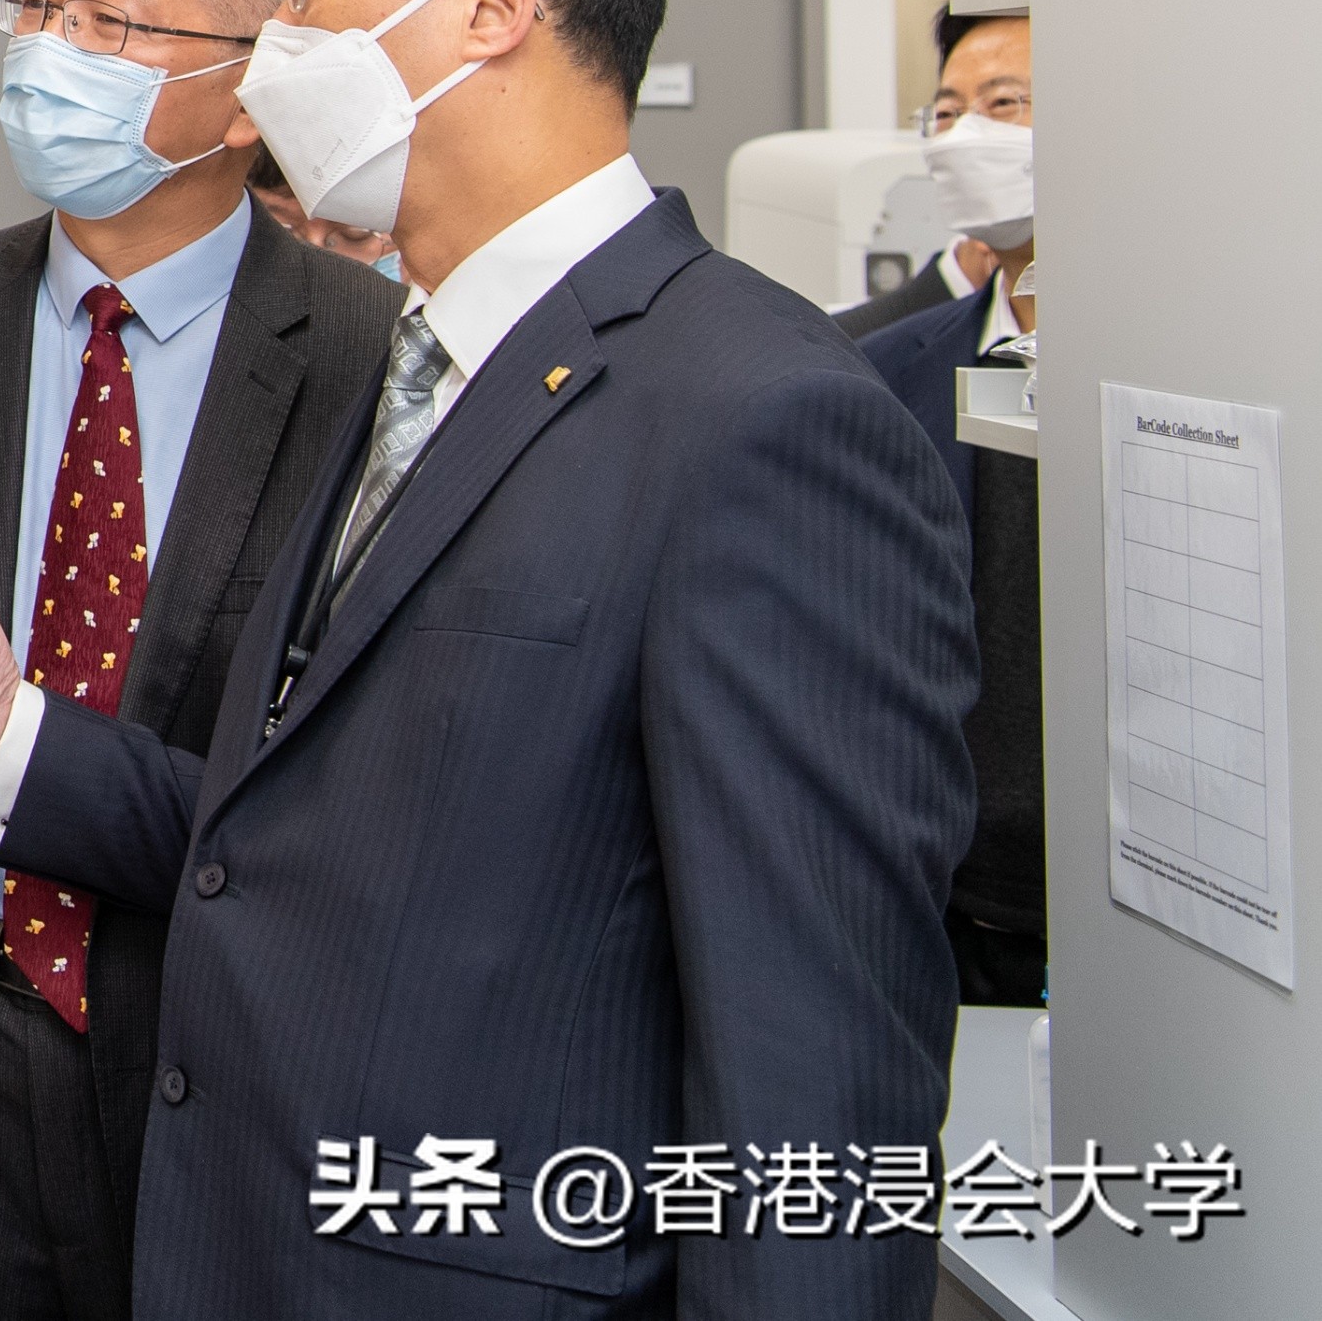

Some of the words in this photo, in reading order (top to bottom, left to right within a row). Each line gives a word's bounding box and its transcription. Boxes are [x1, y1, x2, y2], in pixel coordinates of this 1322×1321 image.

[1137, 416, 1171, 435] BarCode
[1172, 422, 1213, 443] Collection
[1215, 430, 1239, 448] Sheet
